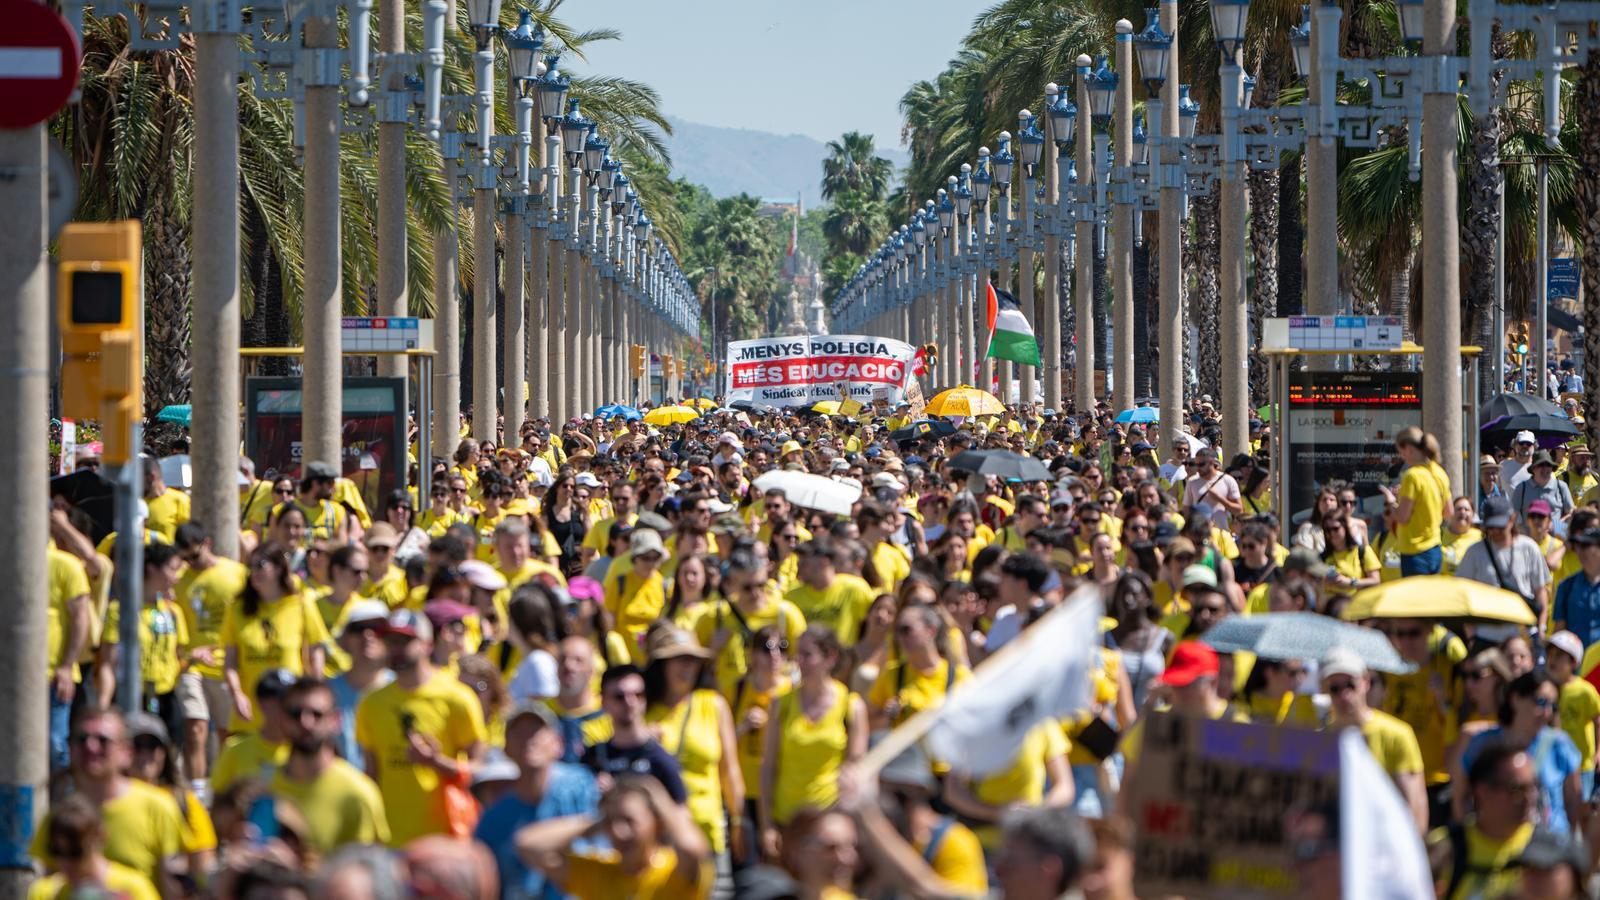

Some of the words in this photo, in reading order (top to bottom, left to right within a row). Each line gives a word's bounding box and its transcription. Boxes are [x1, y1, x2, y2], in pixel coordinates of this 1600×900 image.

[741, 343, 804, 359] MENYS
[811, 342, 889, 355] POLICIA
[738, 364, 783, 383] MÉS
[788, 363, 902, 380] EDUCACIÓ
[762, 388, 805, 399] Sindicat
[349, 447, 360, 456] 16
